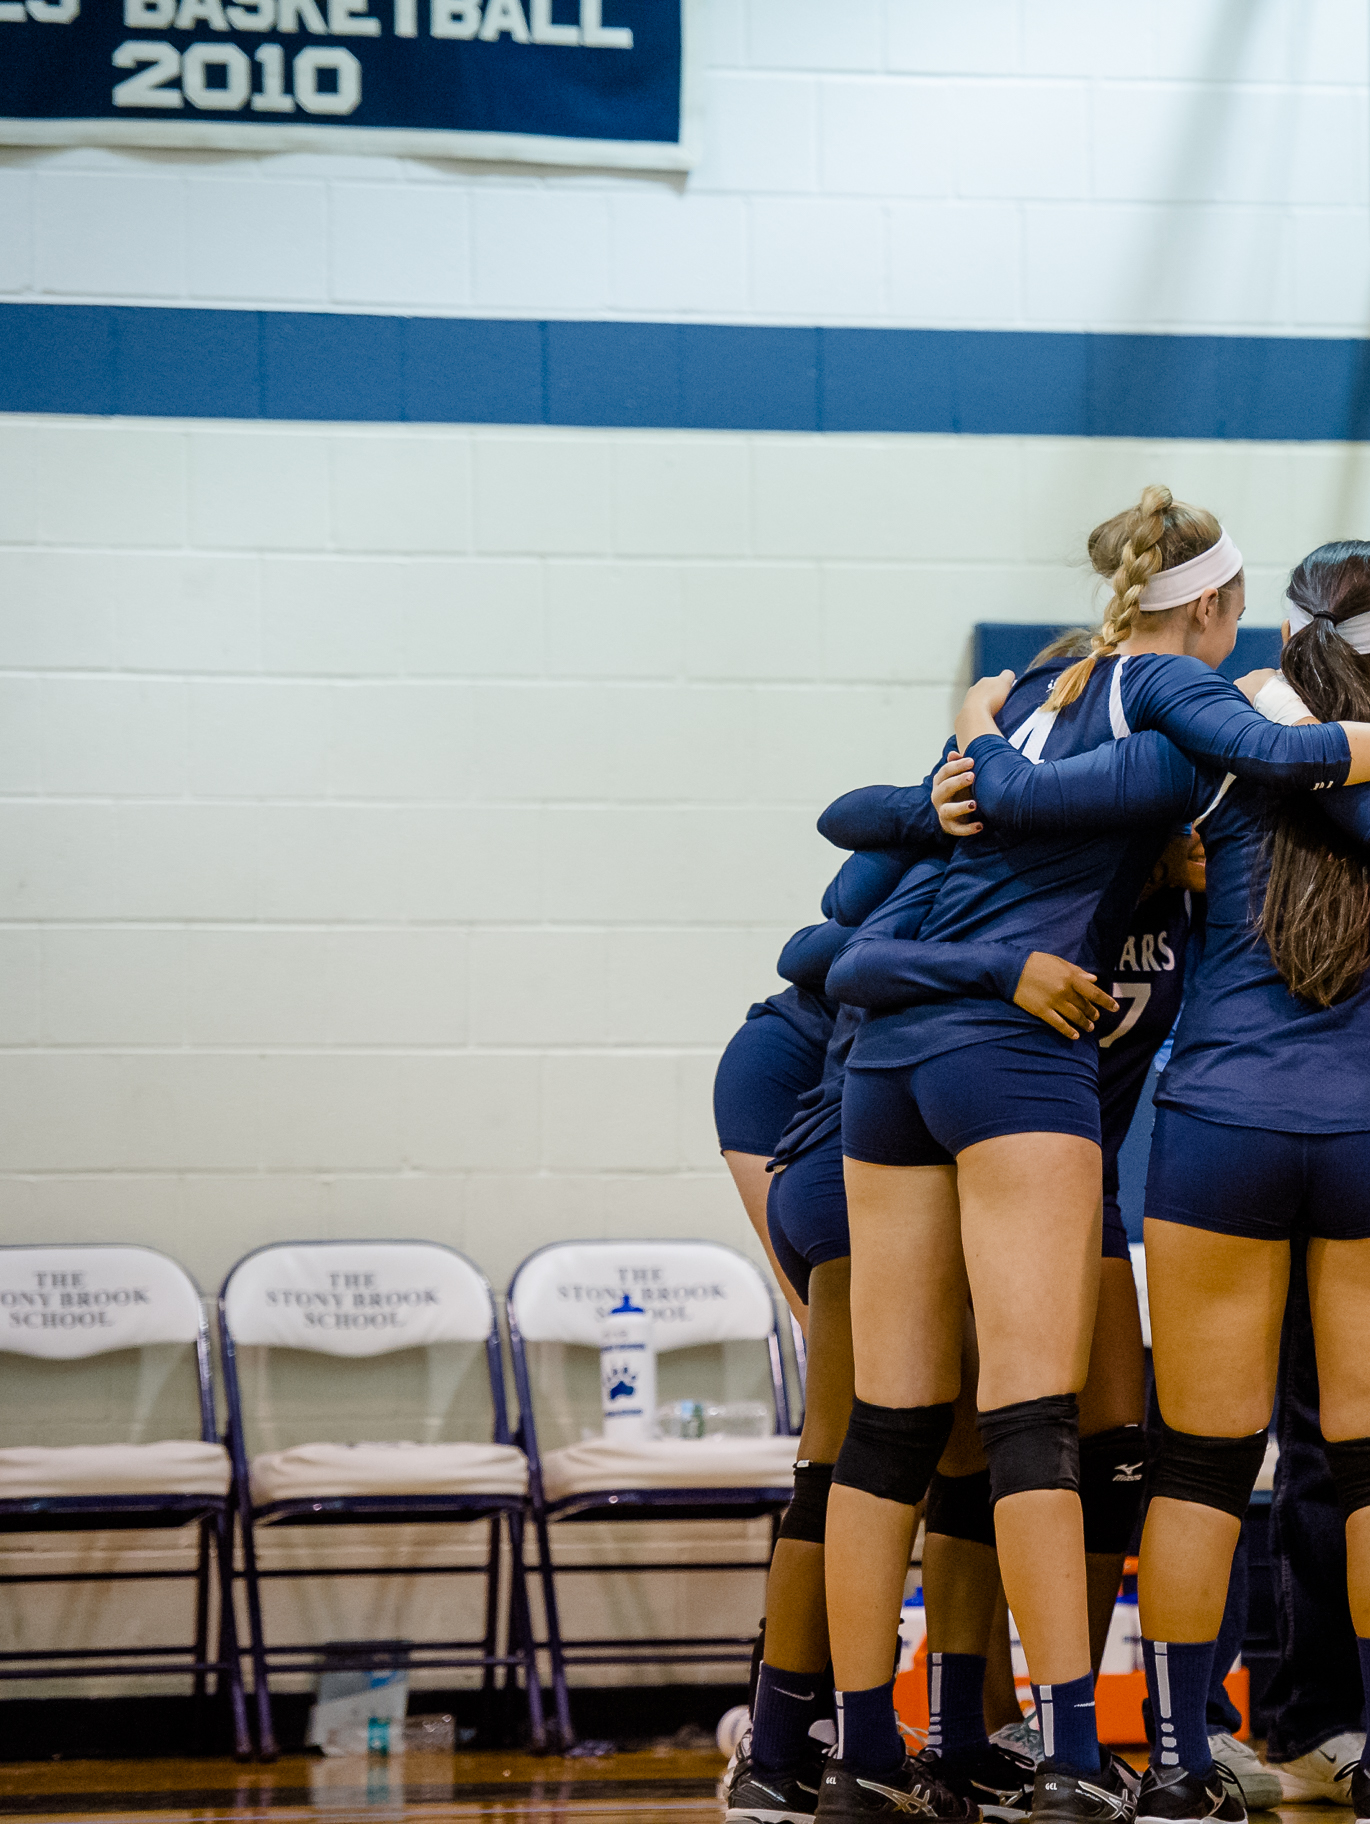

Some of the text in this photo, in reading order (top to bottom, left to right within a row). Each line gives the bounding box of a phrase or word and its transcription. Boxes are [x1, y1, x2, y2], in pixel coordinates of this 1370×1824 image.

[111, 39, 364, 117] 2010
[1098, 982, 1151, 1048] 7
[33, 1270, 85, 1289] THE
[328, 1270, 377, 1290] THE
[617, 1268, 663, 1285] THE
[59, 1287, 151, 1308] BROOK
[265, 1287, 440, 1308] STONY BROOK
[640, 1283, 727, 1303] BROOK
[9, 1311, 116, 1329] SCHOOL
[303, 1312, 406, 1330] SCHOOL
[1044, 1782, 1058, 1791] GEL
